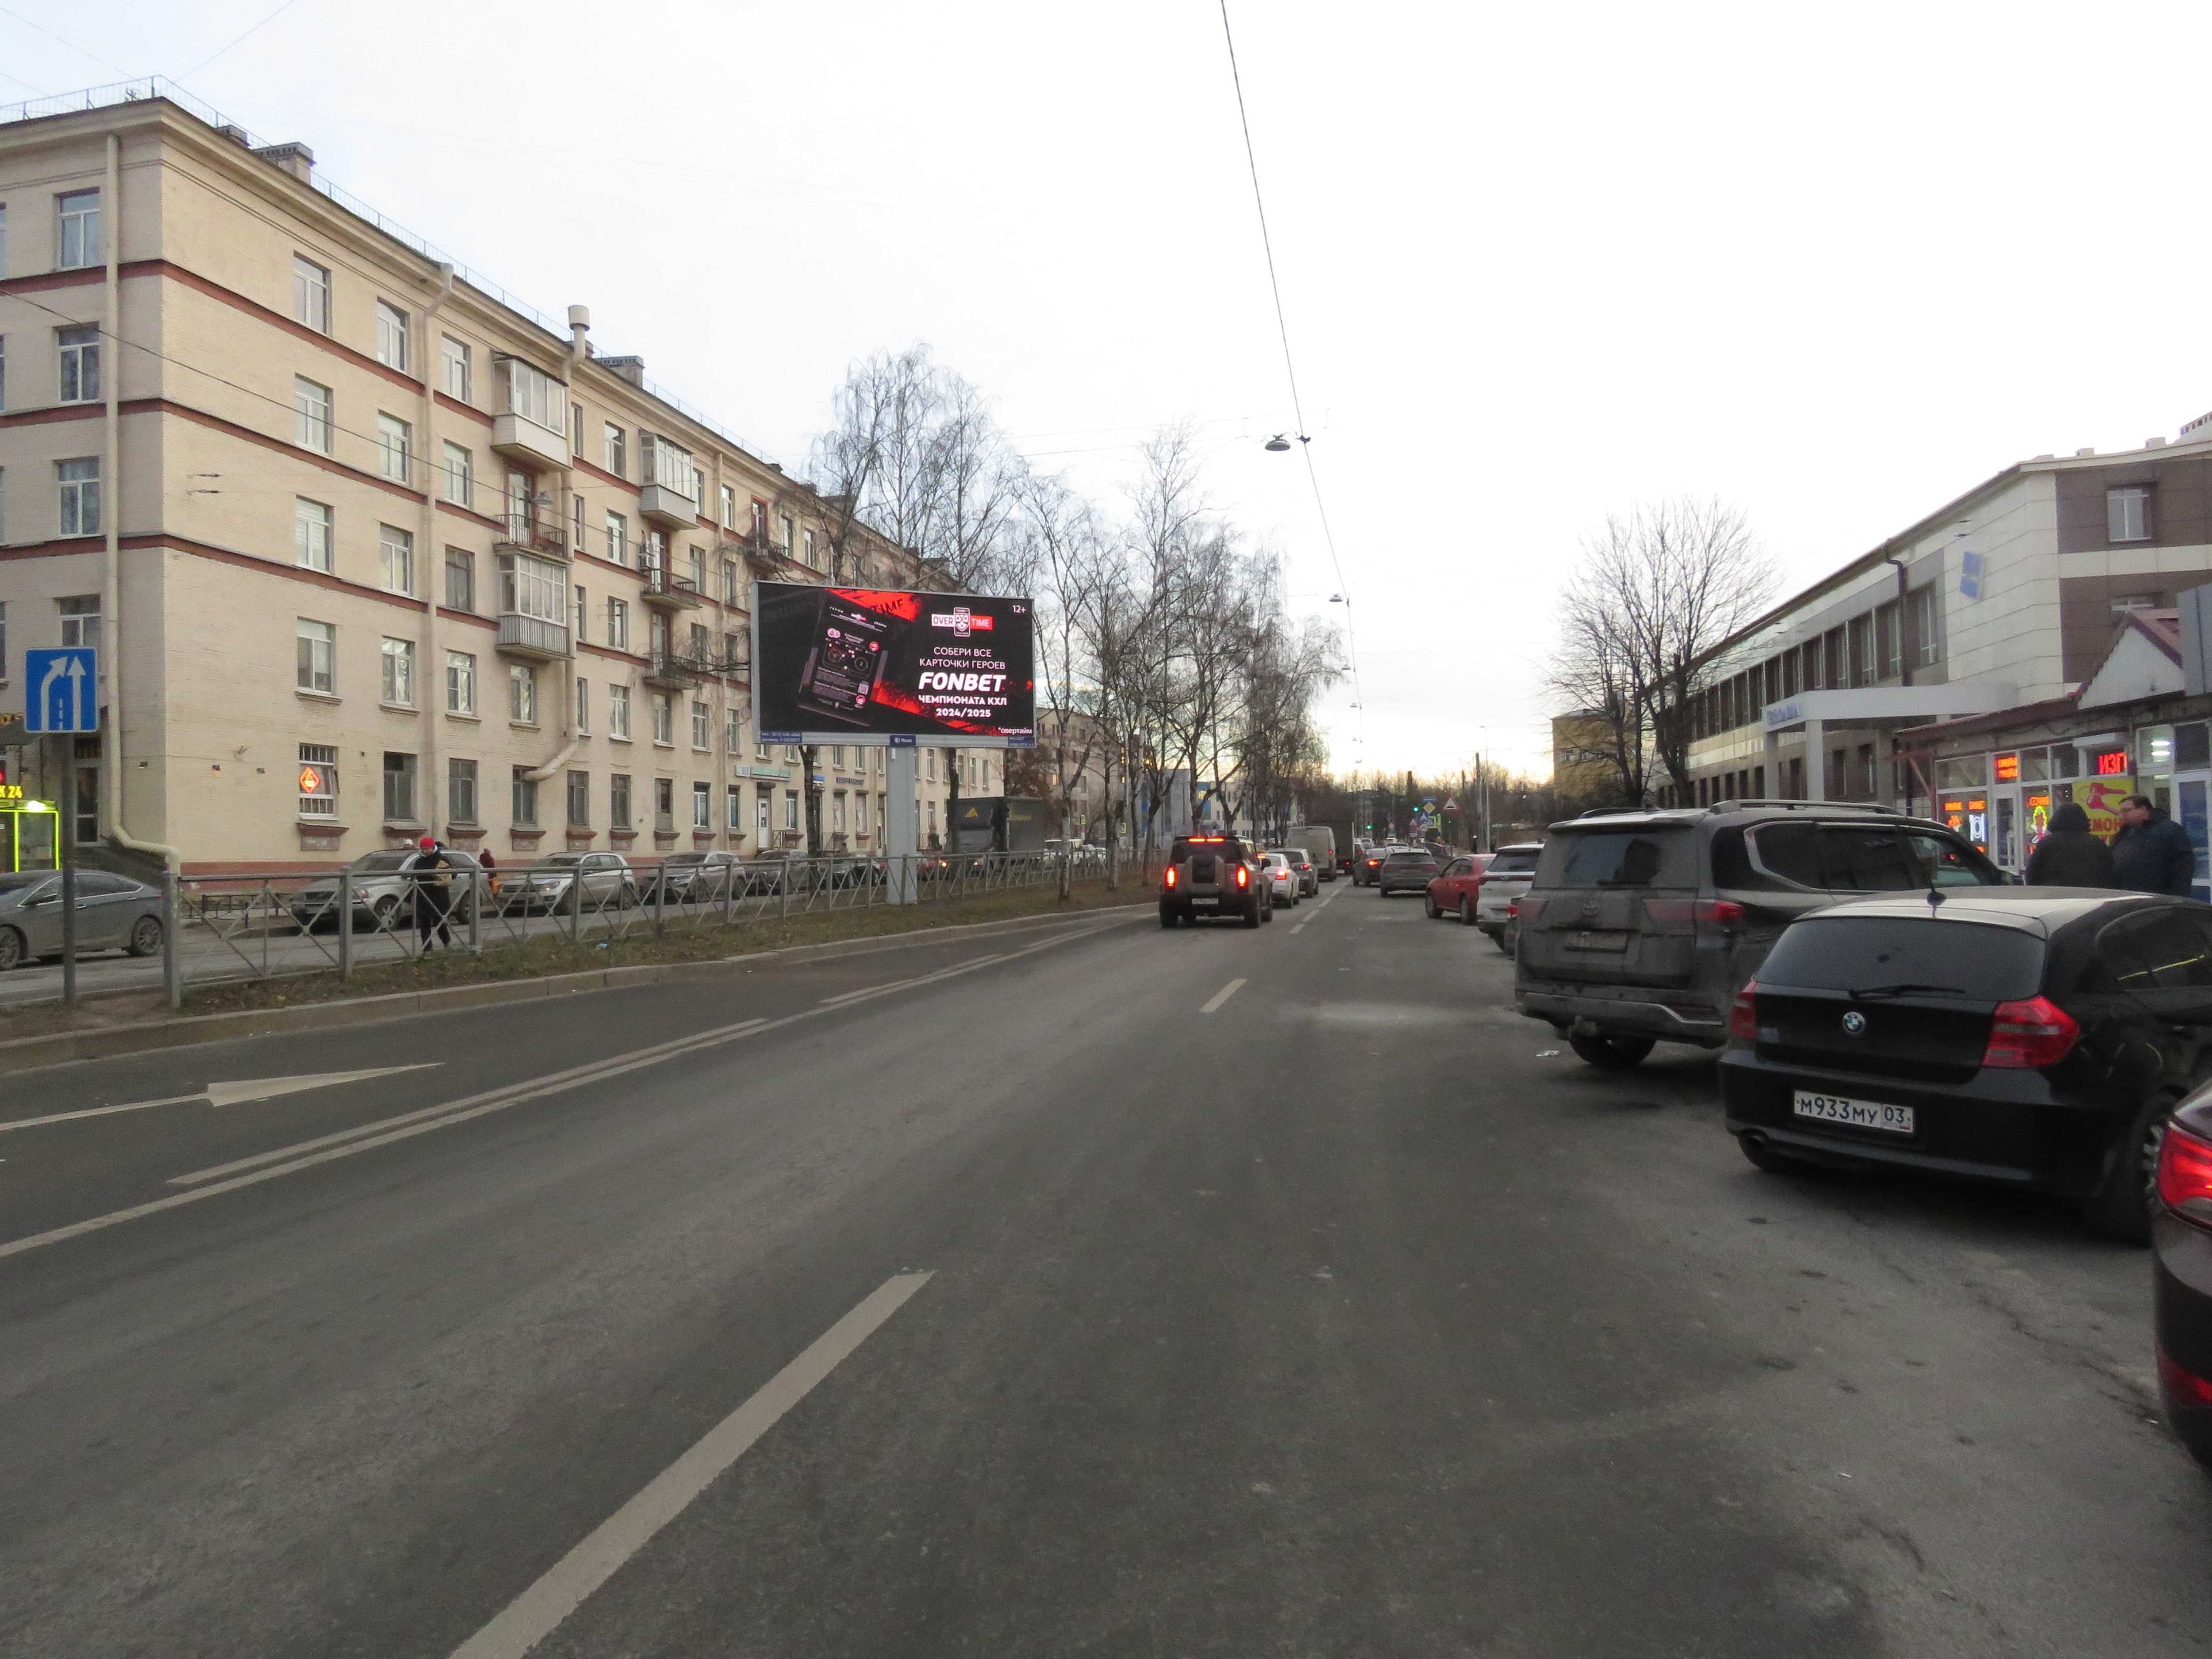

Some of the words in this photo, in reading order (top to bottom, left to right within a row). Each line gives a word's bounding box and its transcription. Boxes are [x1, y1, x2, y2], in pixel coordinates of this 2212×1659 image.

[1012, 605, 1027, 613] 12+
[933, 616, 953, 625] OVER
[971, 618, 990, 627] TIME
[934, 647, 971, 656] СОБЕРИ
[974, 649, 992, 657] ВСЕ
[919, 658, 969, 668] КАРТОЧКИ
[972, 661, 1006, 669] ГЕРОЕВ
[918, 672, 1007, 692] FONBET
[918, 695, 986, 706] ЧЕМПИОНАТА
[987, 698, 1007, 706] КХЛ
[936, 708, 991, 718] 2024/2025
[8, 785, 24, 799] 24
[1800, 1097, 1877, 1124] М933МУ
[1884, 1106, 1905, 1123] 03
